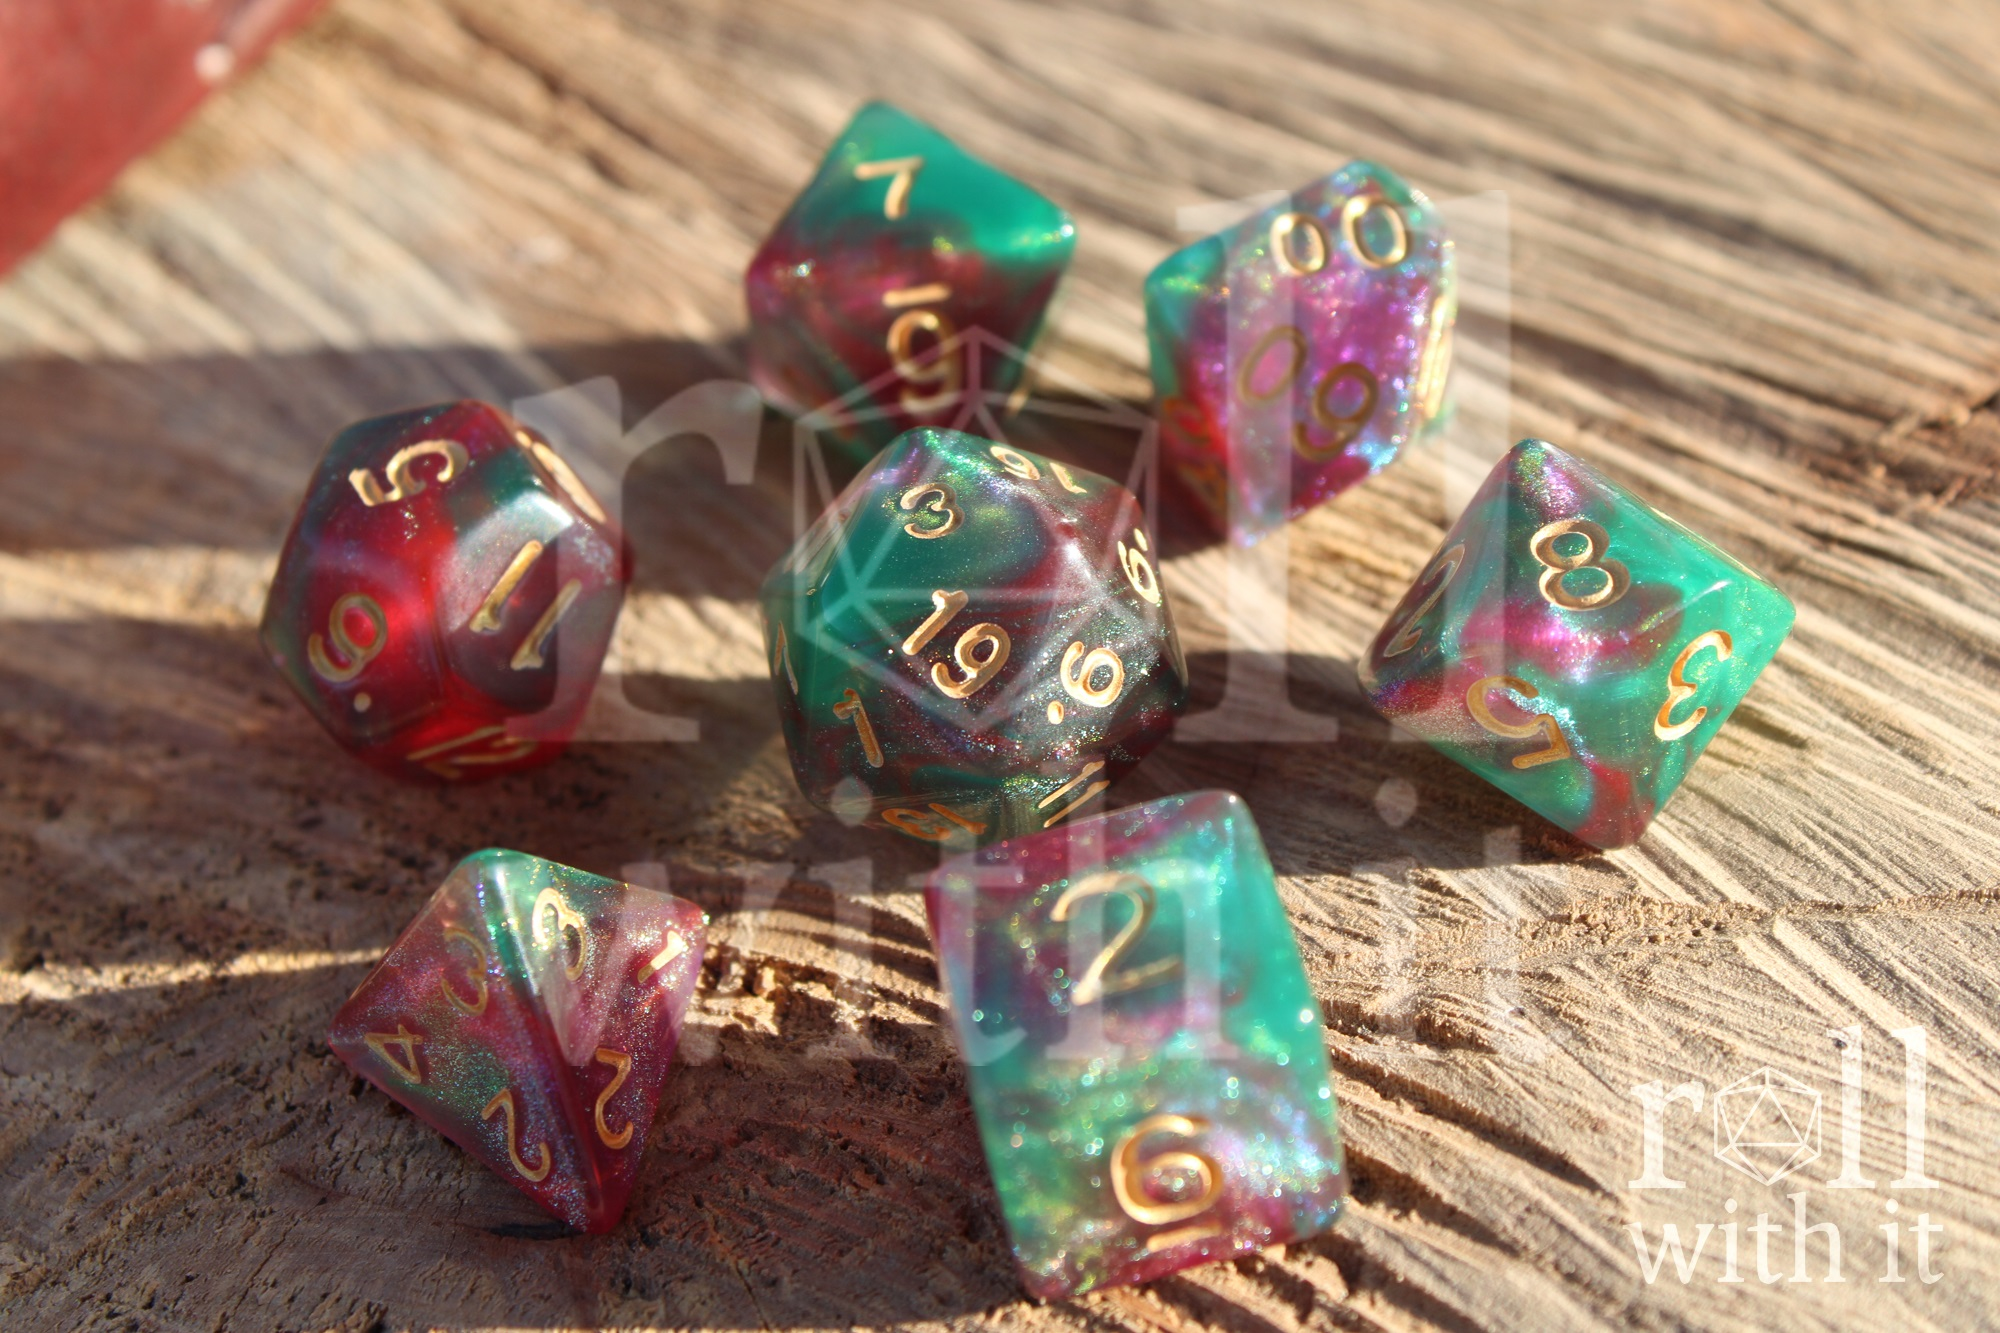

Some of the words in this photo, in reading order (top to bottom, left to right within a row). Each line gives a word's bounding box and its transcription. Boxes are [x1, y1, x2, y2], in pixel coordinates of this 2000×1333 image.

[854, 156, 923, 219] 7
[1270, 194, 1413, 276] 00
[348, 438, 469, 507] 5
[900, 482, 965, 539] 3
[1384, 544, 1466, 657] 2
[1530, 518, 1631, 611] 8
[902, 589, 1011, 699] 19
[1653, 629, 1732, 741] 3
[1467, 675, 1571, 769] 5
[441, 926, 488, 1016] 3
[532, 887, 588, 981] 3
[637, 930, 685, 984] 1
[1050, 872, 1182, 1007] 2
[364, 1024, 423, 1084] 4
[595, 1047, 634, 1149] 2
[481, 1088, 551, 1182] 2
